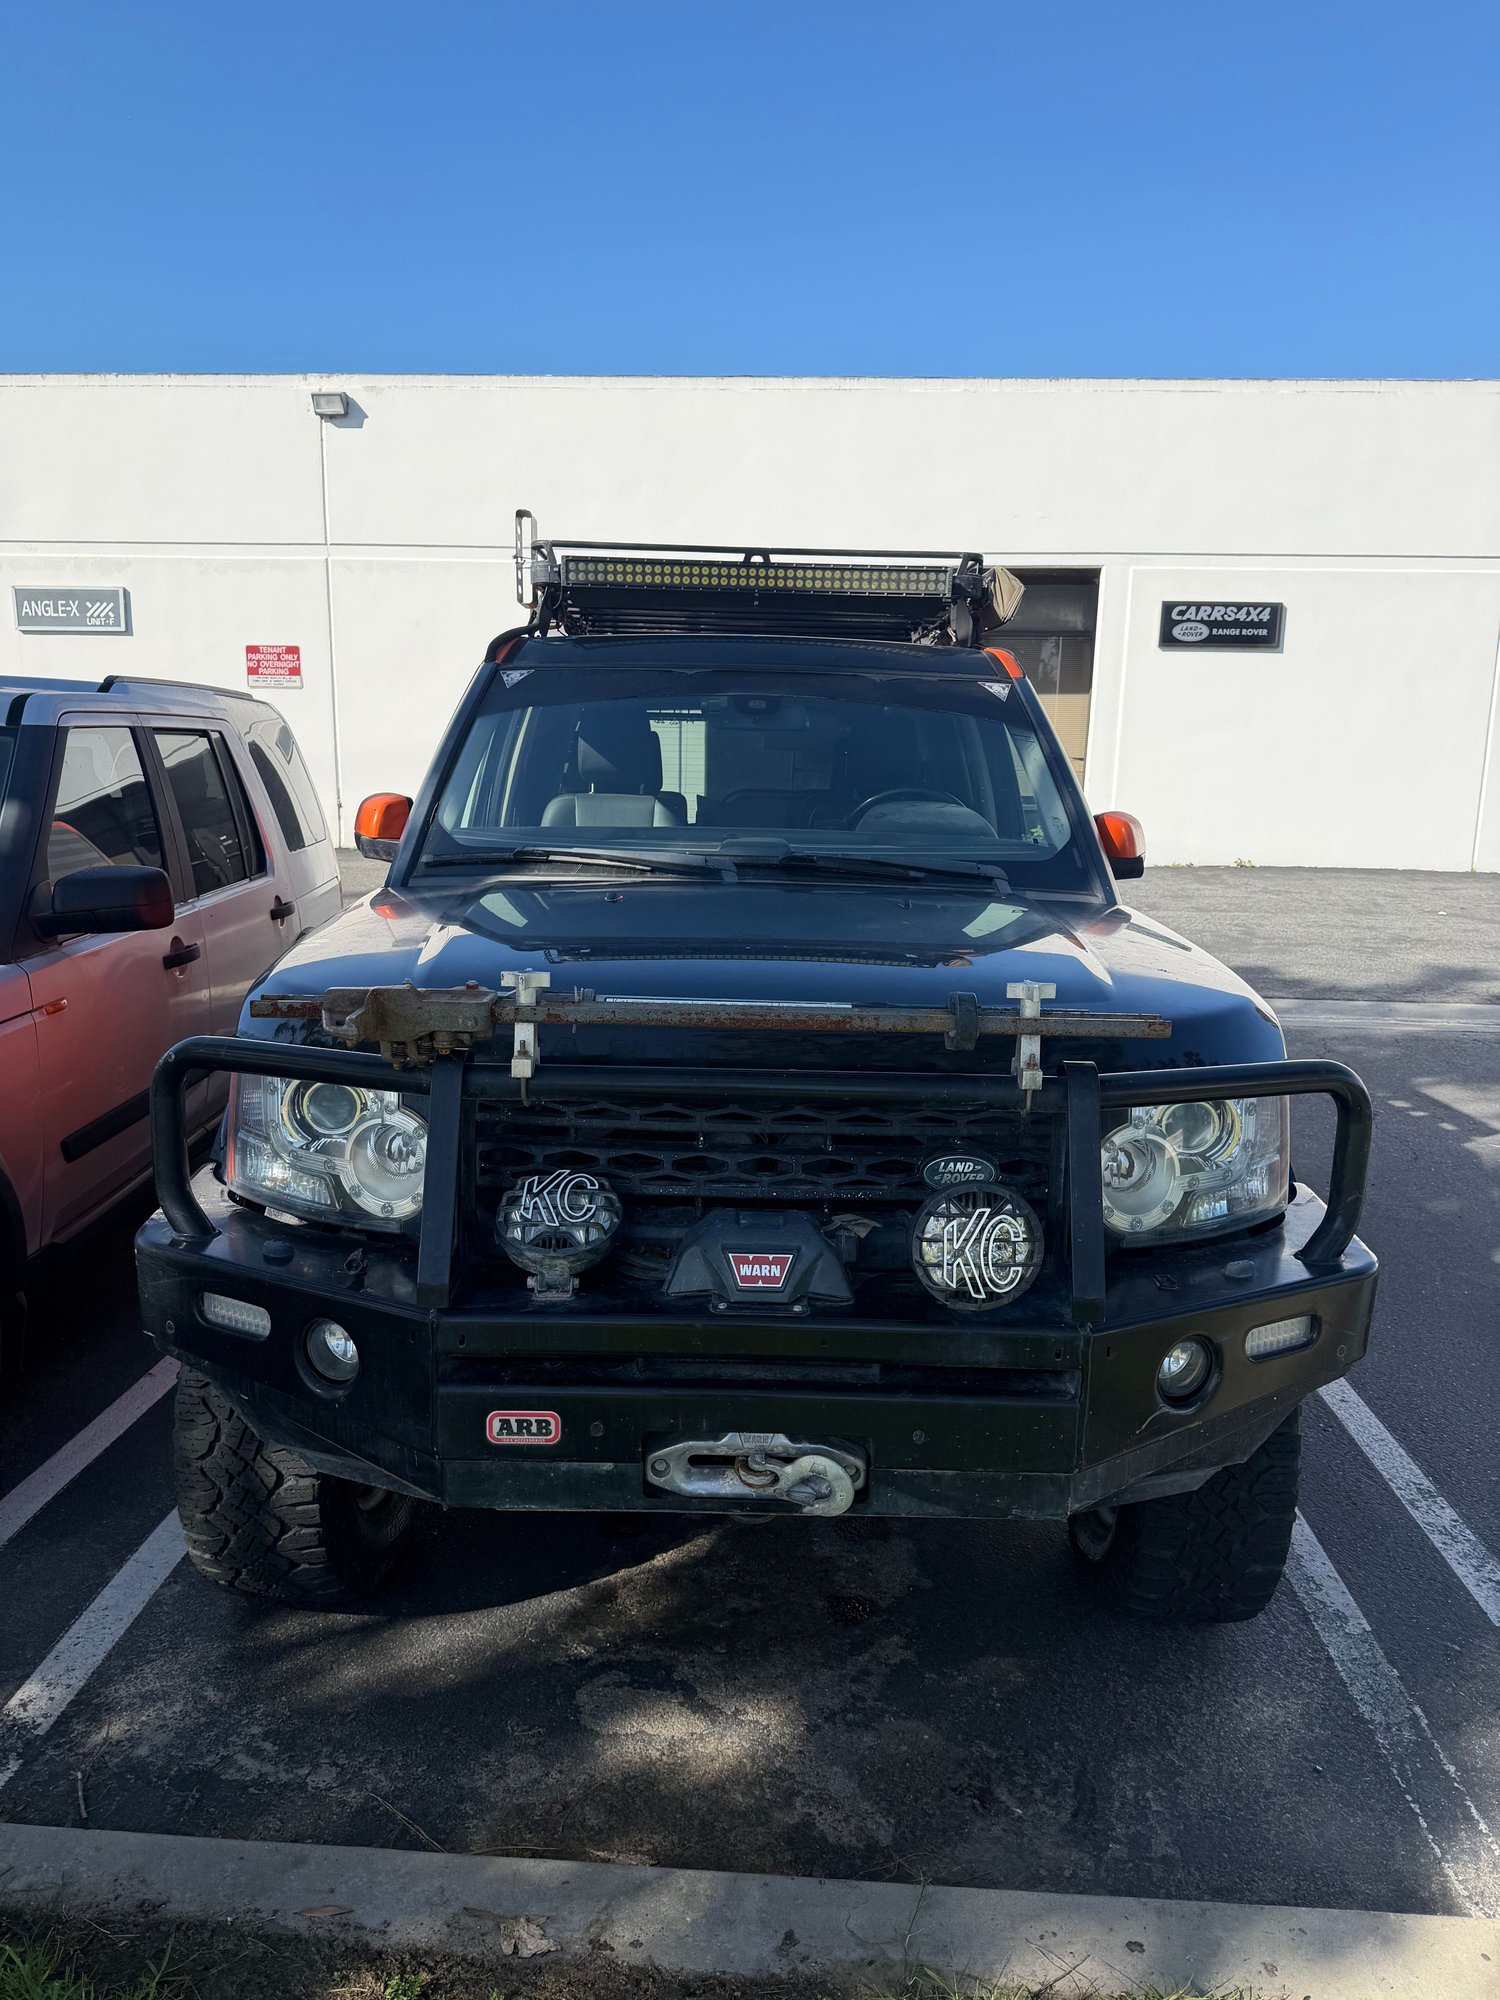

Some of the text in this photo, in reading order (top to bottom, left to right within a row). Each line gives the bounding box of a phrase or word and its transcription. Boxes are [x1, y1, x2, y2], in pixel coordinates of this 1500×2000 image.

[22, 600, 80, 617] ANGLE-X
[1171, 605, 1272, 622] CARRS4X4
[86, 617, 115, 625] UNIT-F
[1212, 628, 1268, 636] RANGE ROVER
[247, 653, 299, 661] PARKING ONLY
[247, 660, 300, 669] NO OVERNIGHT
[258, 667, 289, 675] PARKING
[938, 1161, 974, 1172] LAND
[520, 1169, 599, 1226] KC
[943, 1208, 1022, 1299] KC
[740, 1264, 780, 1277] WARN
[496, 1418, 553, 1437] ARB
